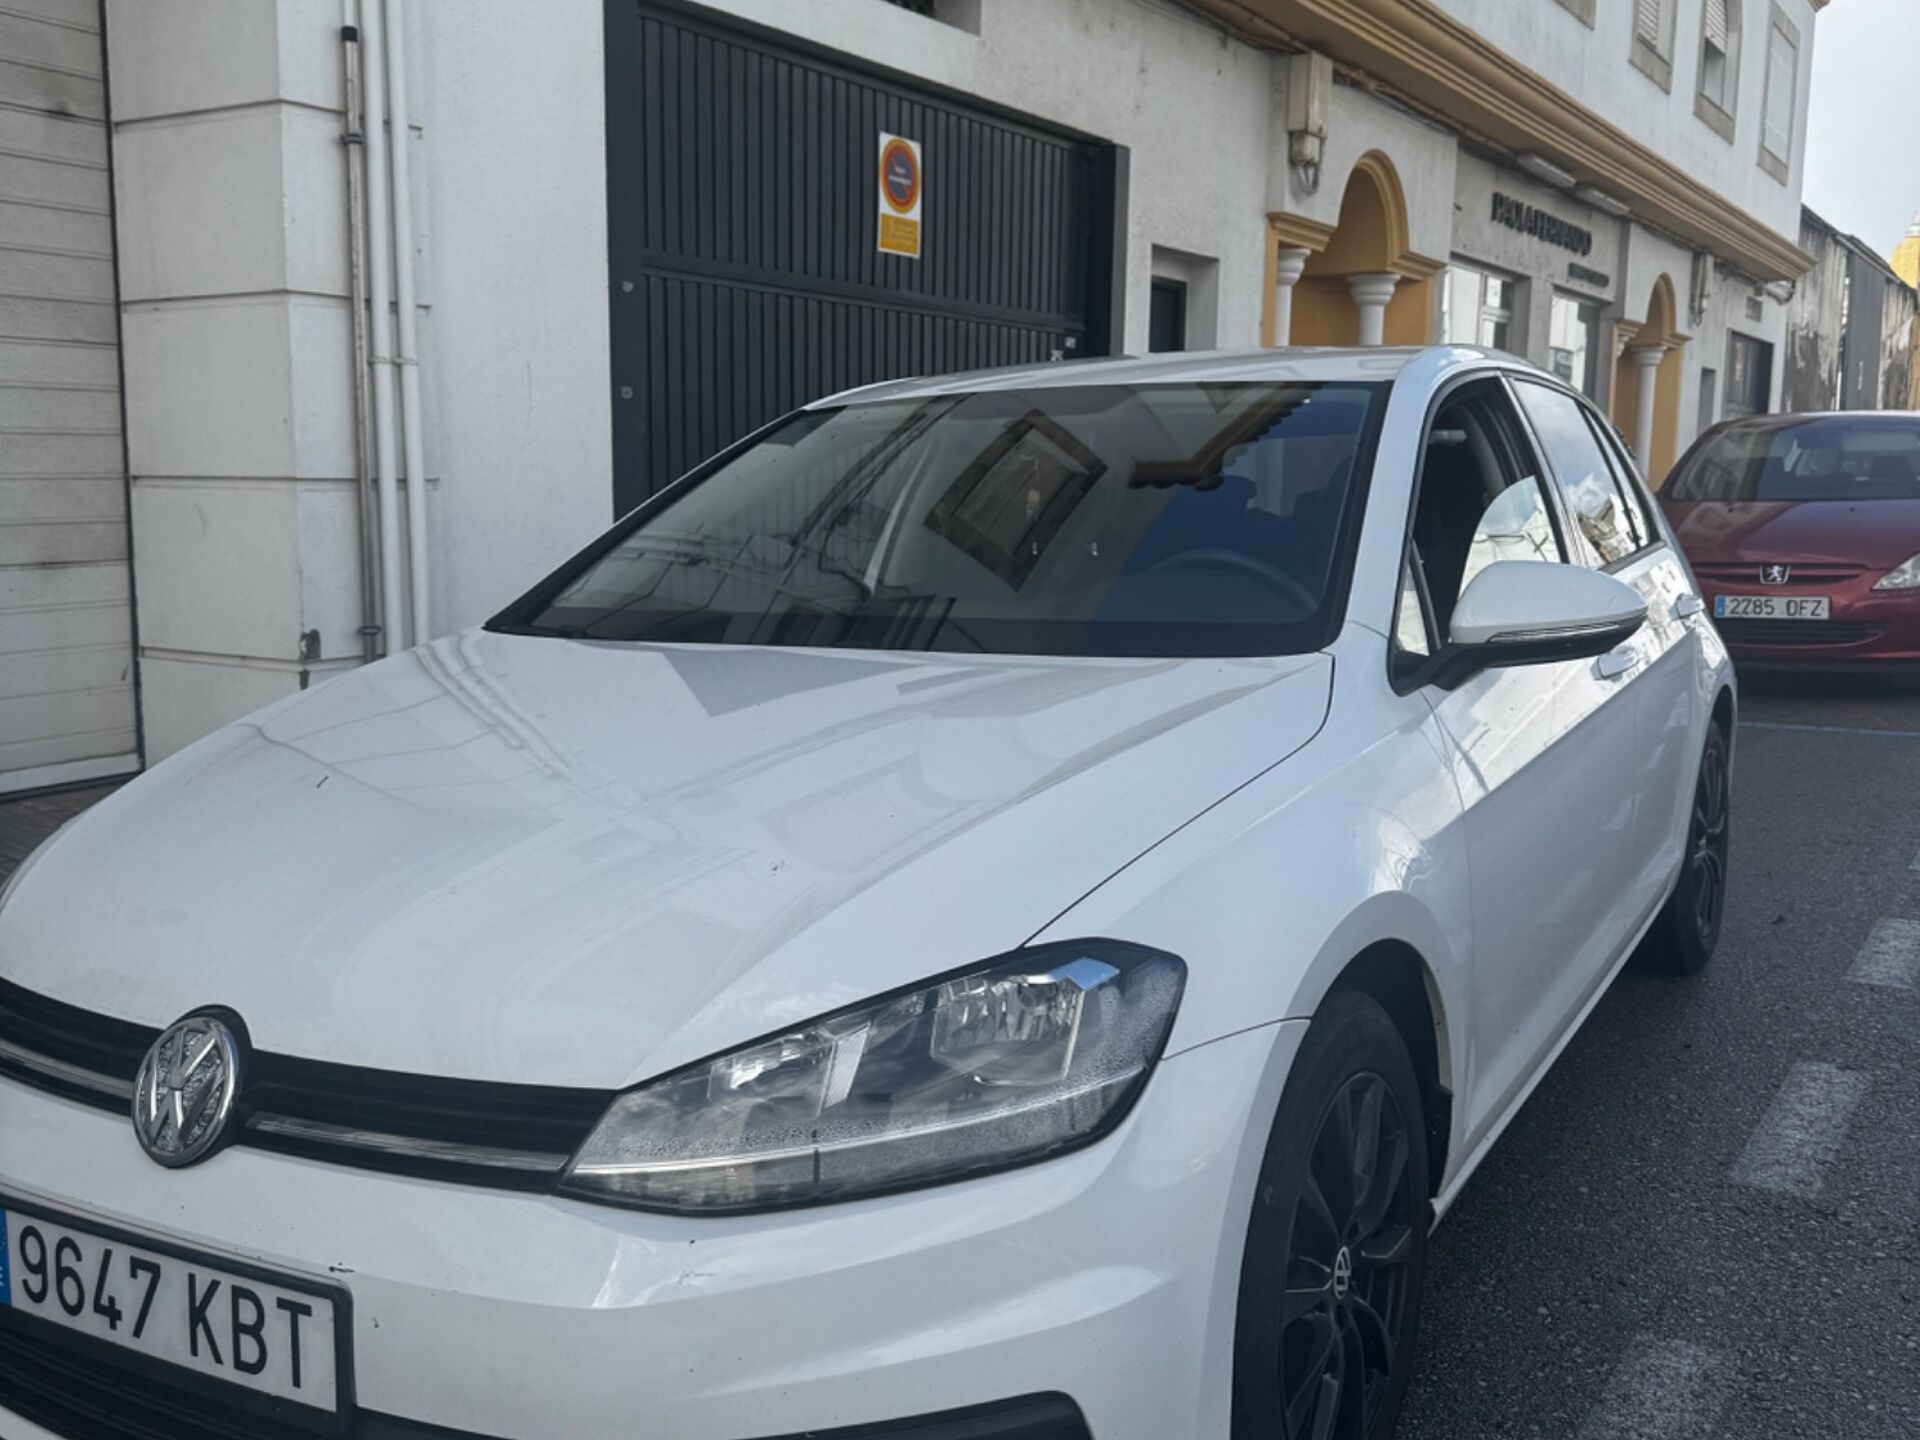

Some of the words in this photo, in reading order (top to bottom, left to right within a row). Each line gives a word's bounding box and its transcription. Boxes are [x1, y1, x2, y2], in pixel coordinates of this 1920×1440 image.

[1729, 598, 1775, 615] 2285
[19, 1225, 161, 1339] 9647
[188, 1272, 312, 1389] KBT
